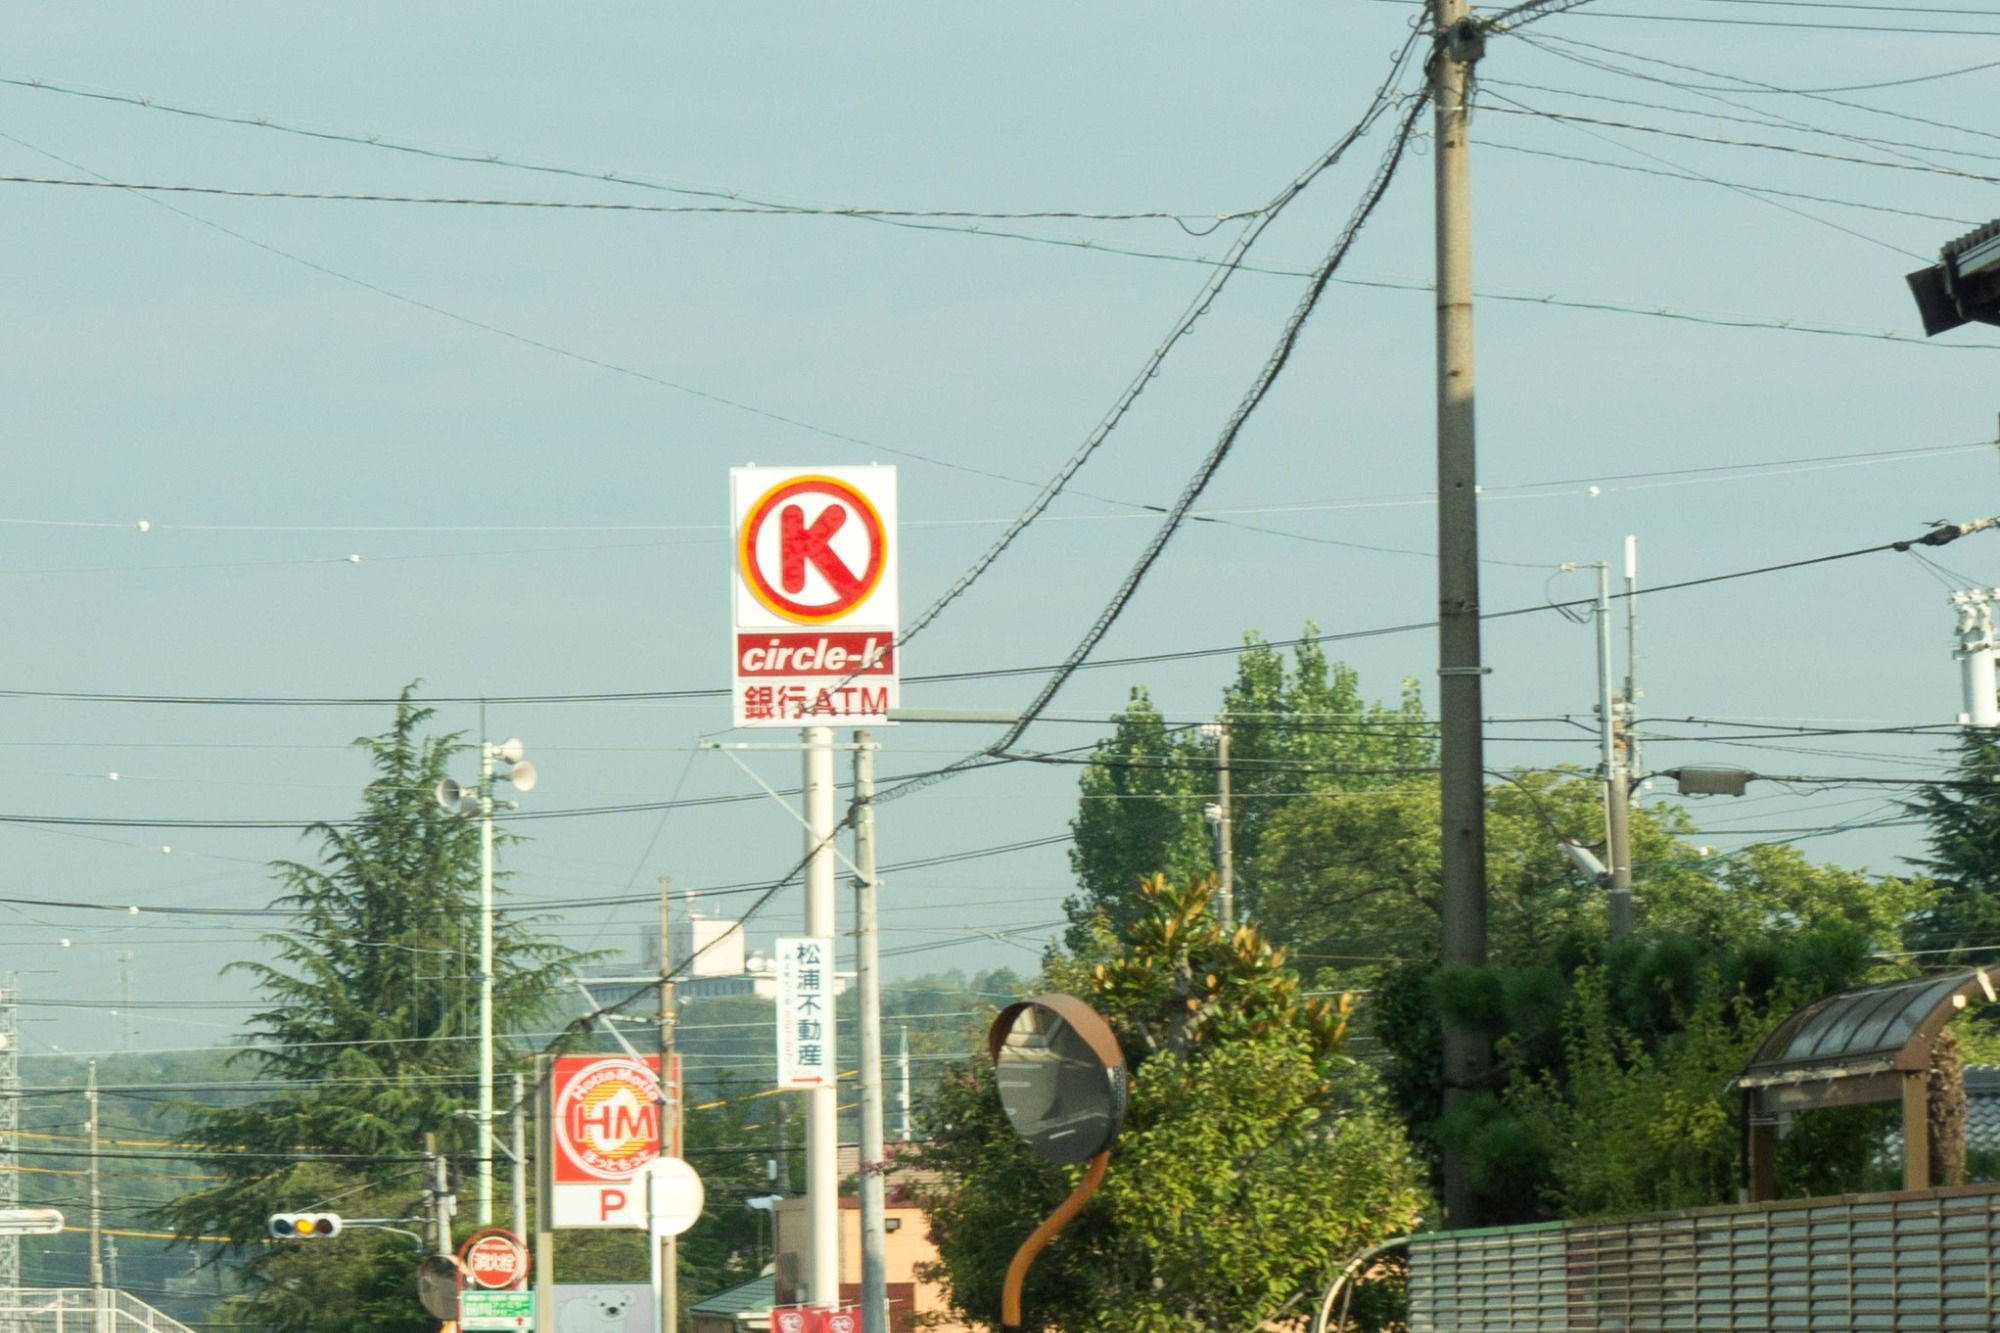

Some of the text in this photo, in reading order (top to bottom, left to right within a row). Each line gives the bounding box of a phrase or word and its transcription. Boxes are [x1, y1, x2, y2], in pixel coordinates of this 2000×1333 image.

[781, 504, 861, 602] K
[741, 638, 885, 672] circle-k
[744, 686, 889, 719] 銀行ATM
[796, 943, 823, 1067] 松浦不動産
[573, 1103, 659, 1142] HM
[600, 1189, 627, 1221] P
[473, 1253, 516, 1272] 消火栓
